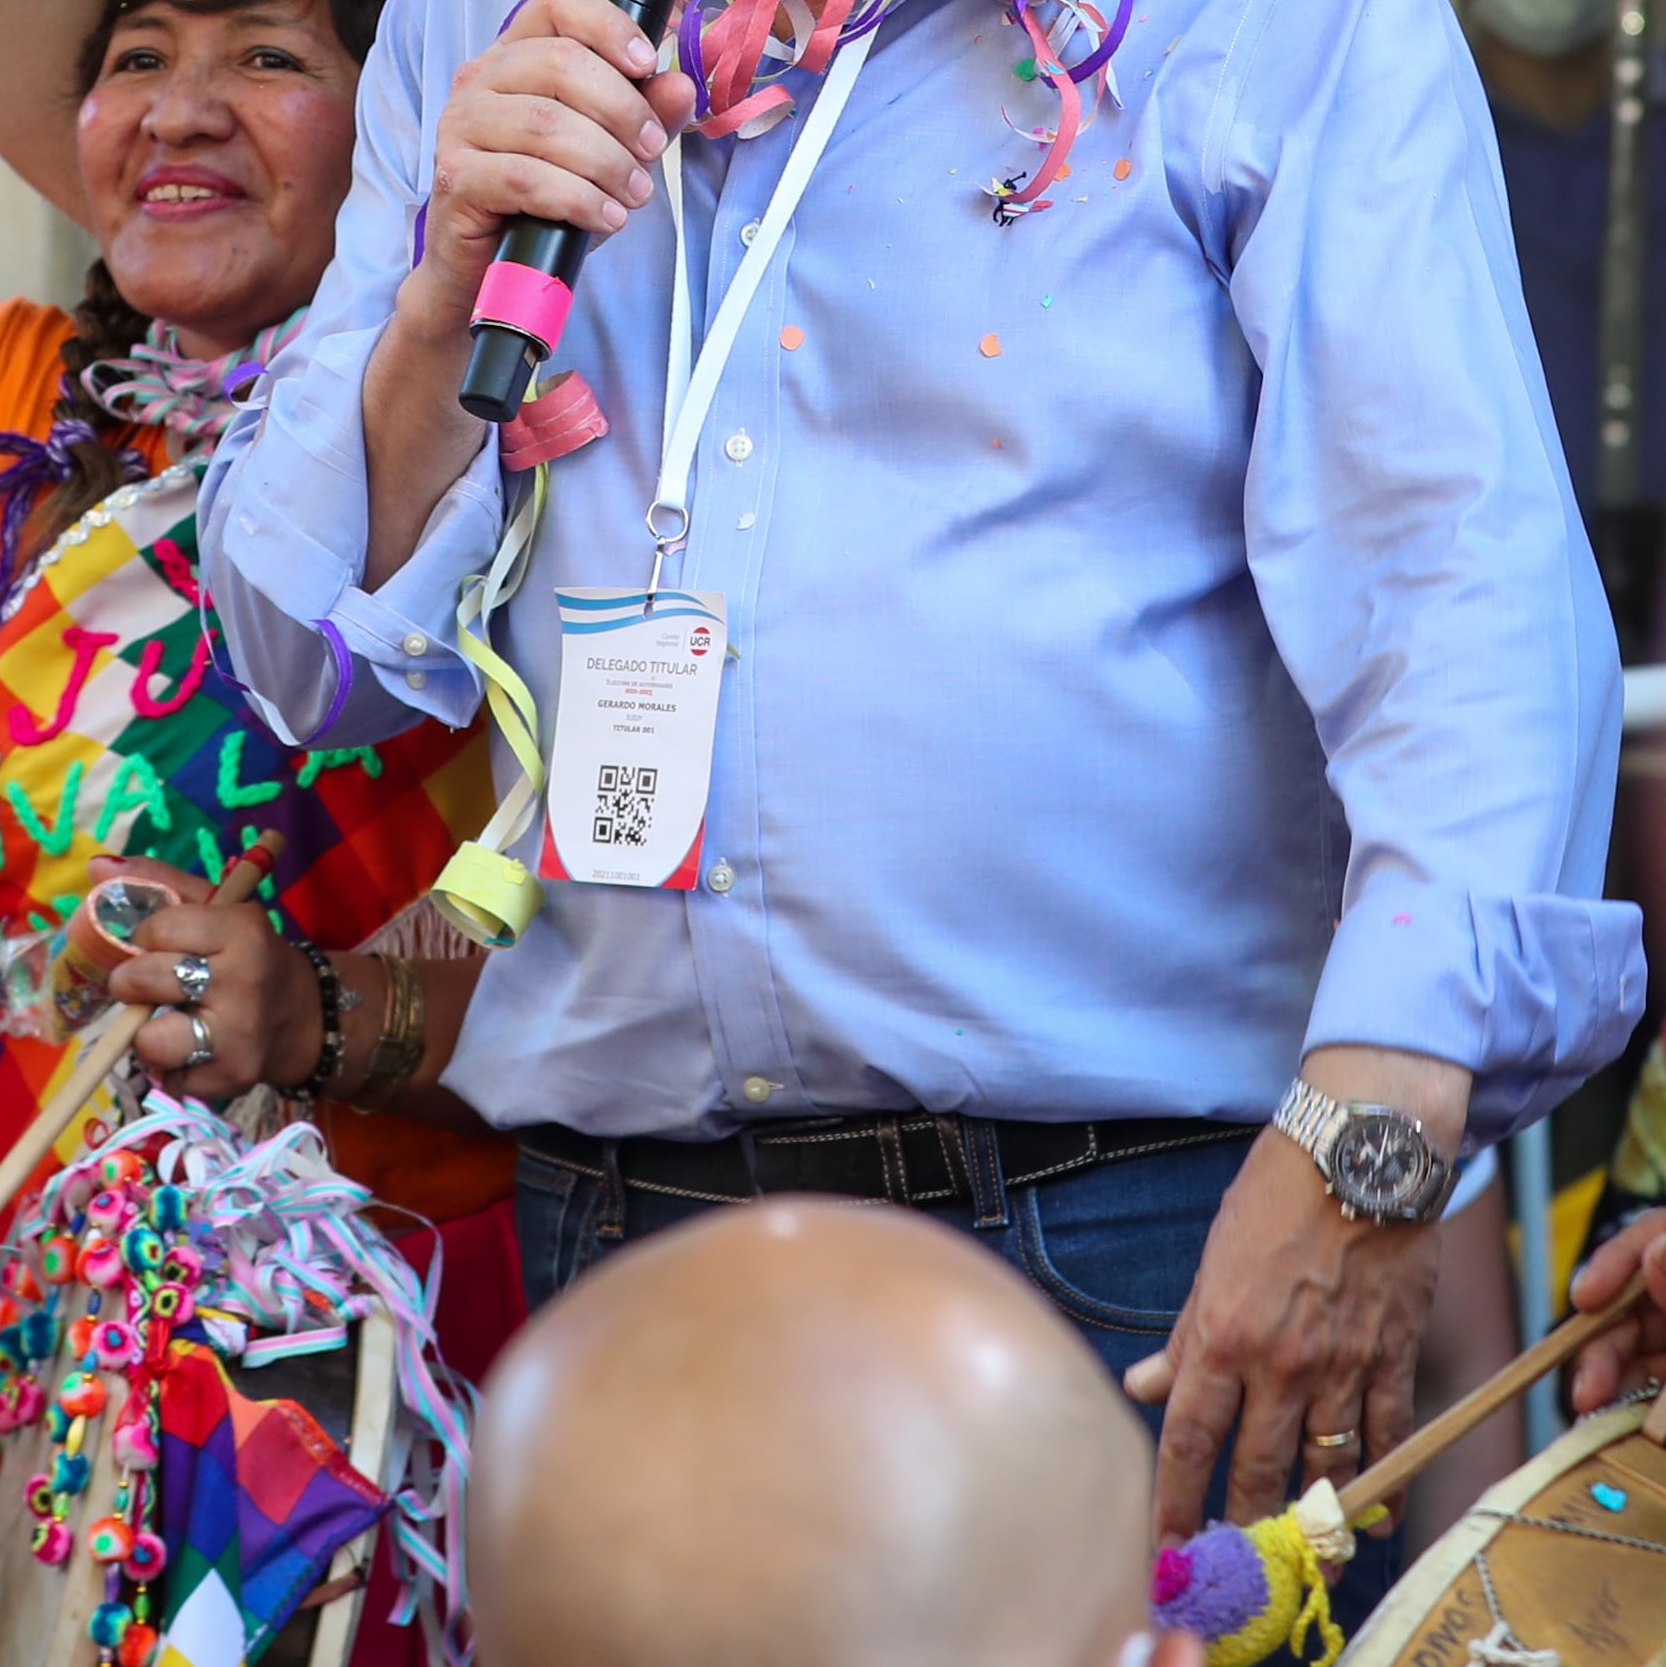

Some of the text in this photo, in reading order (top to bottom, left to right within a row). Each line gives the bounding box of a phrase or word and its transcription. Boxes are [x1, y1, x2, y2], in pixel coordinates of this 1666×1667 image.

[690, 636, 711, 647] UCR
[586, 657, 698, 676] DELEGADO TITULAR
[597, 699, 676, 713] GERARDO MORALES
[613, 724, 640, 733] TITULAR
